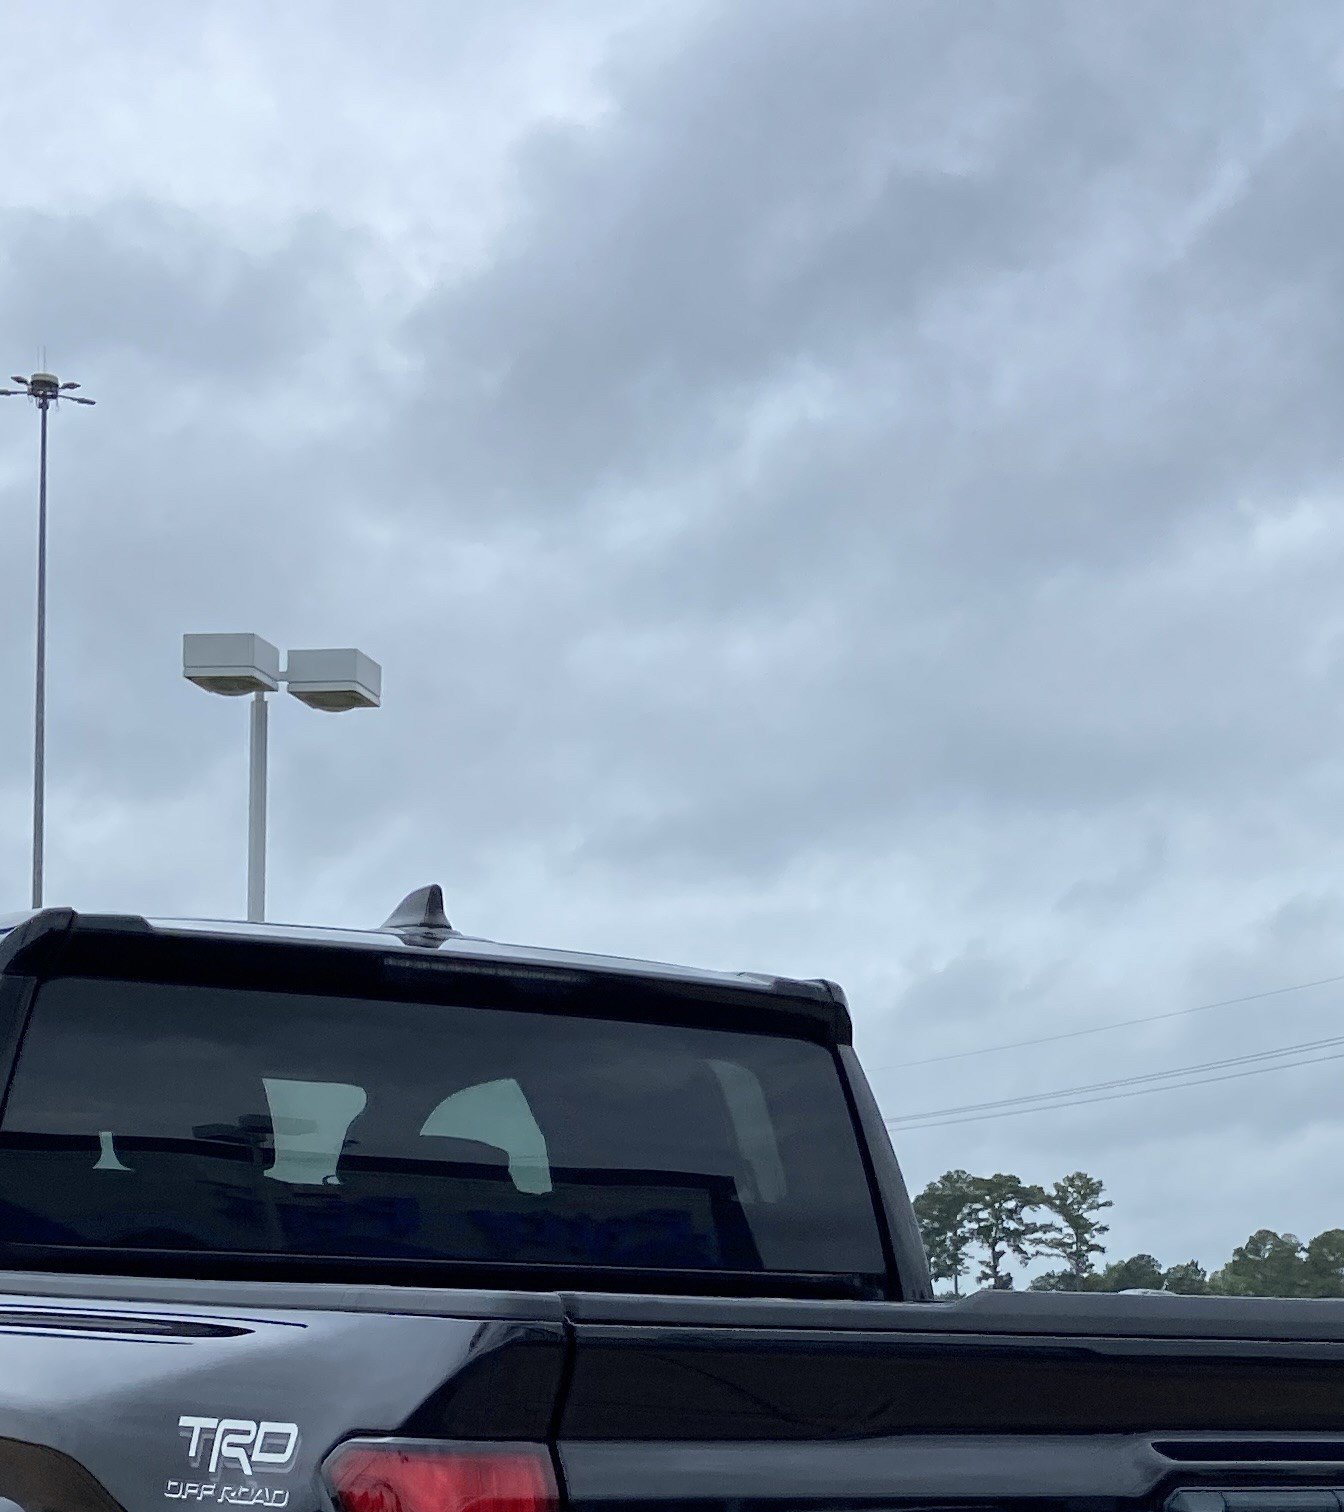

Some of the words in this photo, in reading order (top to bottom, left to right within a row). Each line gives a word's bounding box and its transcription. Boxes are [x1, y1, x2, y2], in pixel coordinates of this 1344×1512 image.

[179, 1416, 299, 1476] TRD
[164, 1479, 216, 1500] OFF
[217, 1485, 290, 1508] ROAD
